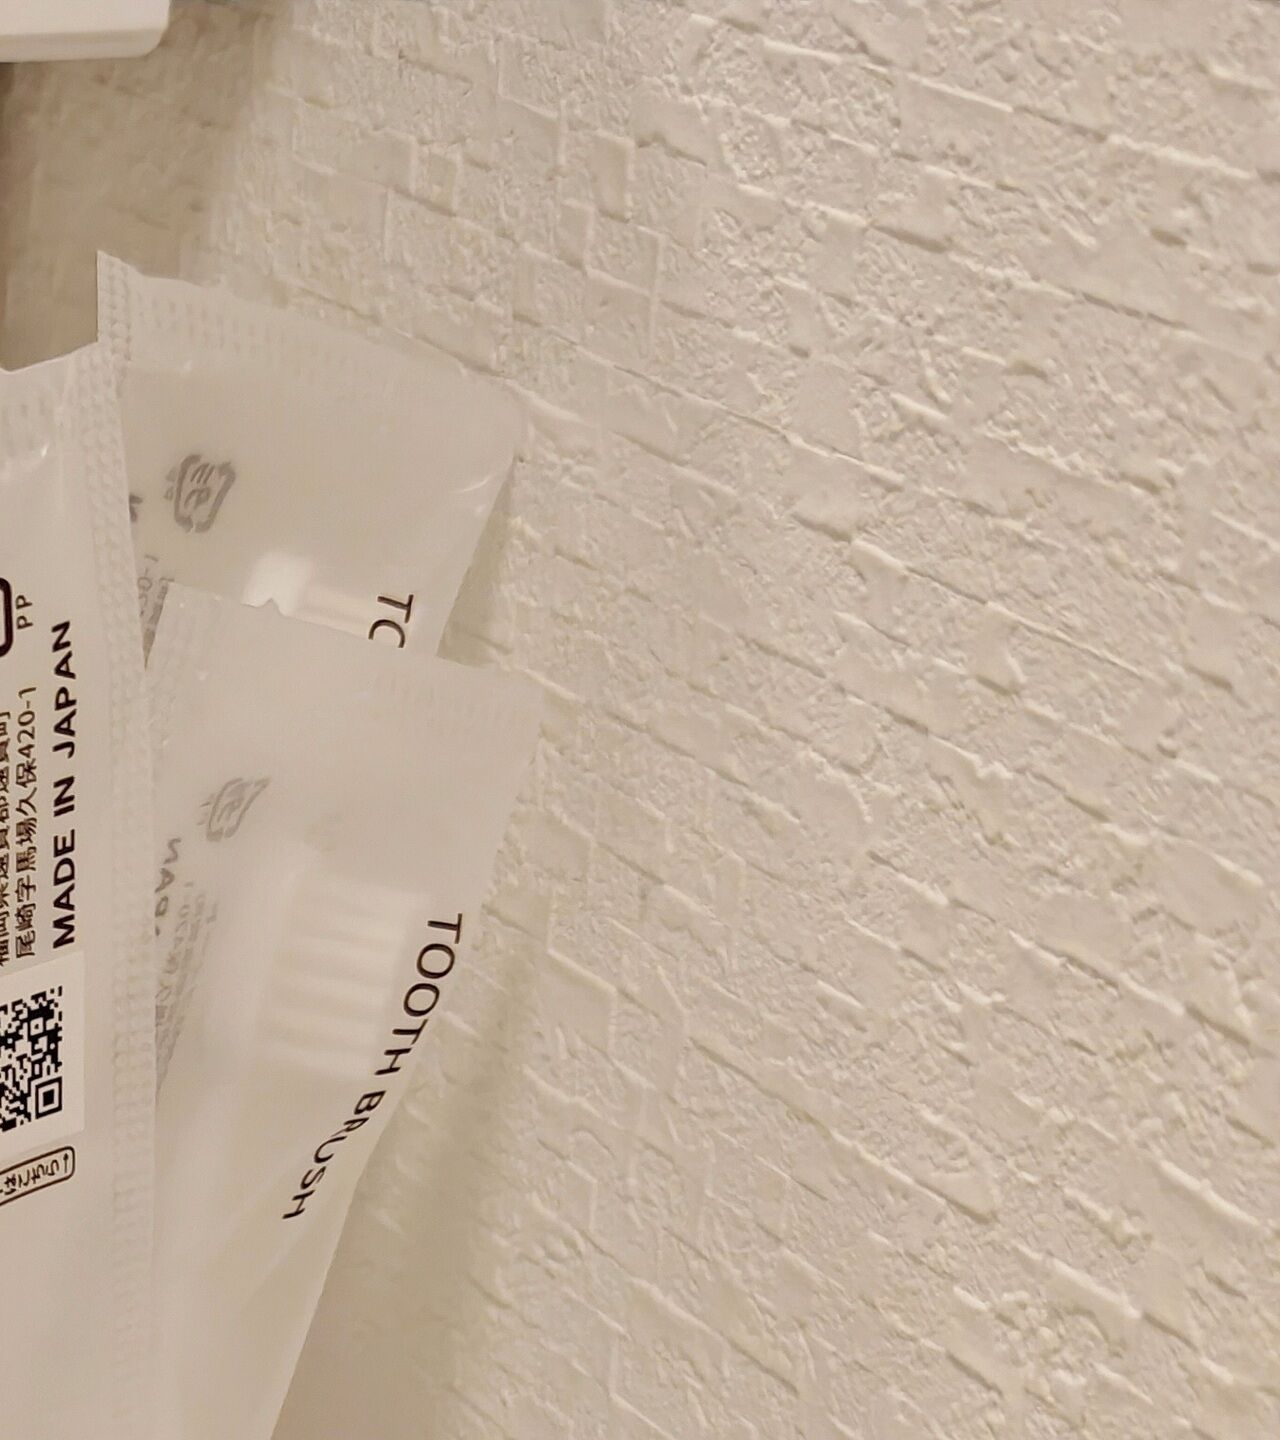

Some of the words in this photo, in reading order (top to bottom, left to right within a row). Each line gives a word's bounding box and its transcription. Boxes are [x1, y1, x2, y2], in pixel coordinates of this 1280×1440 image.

[51, 621, 78, 760] JAPAN
[52, 775, 77, 817] IN
[52, 828, 77, 949] MADE
[370, 913, 462, 1077] TOOTH
[282, 1090, 387, 1220] BRUSH
